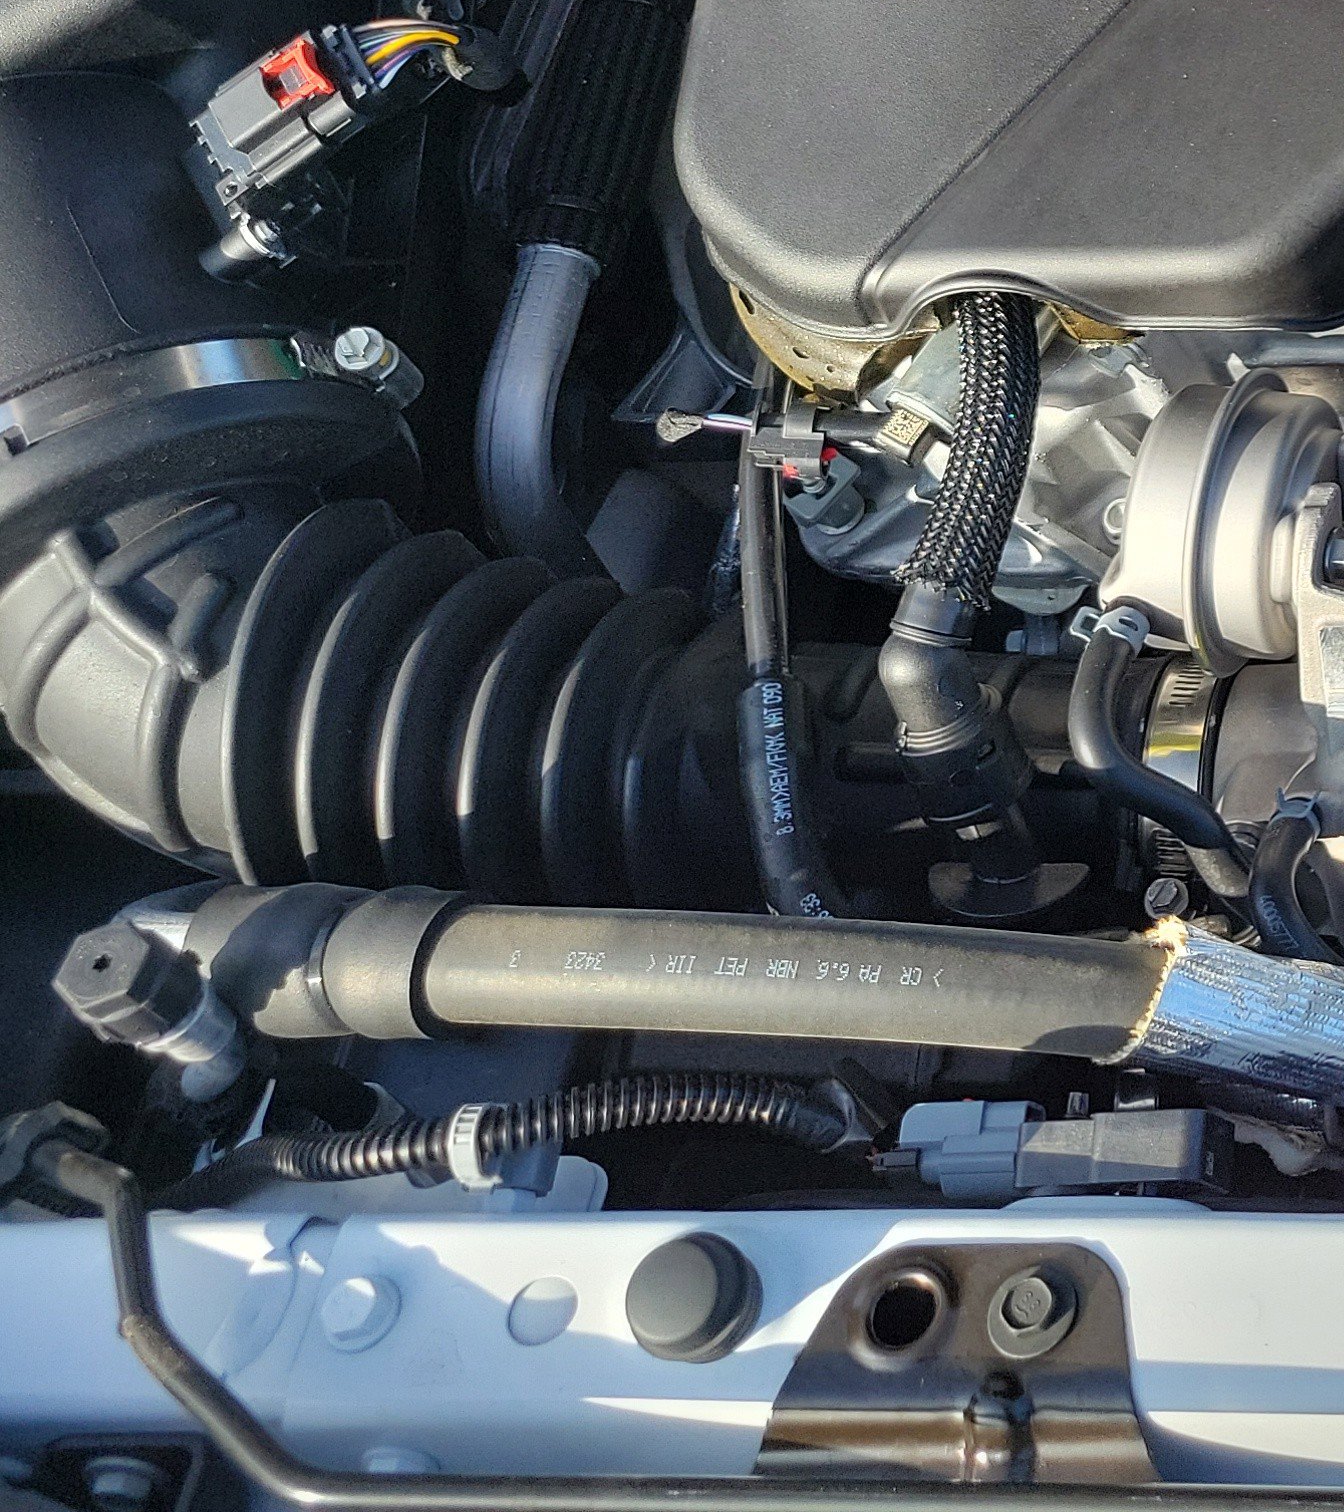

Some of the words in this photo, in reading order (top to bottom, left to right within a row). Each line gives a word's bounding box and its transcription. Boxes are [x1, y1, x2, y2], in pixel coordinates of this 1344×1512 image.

[563, 950, 607, 971] 3423
[664, 954, 696, 975] IIR
[714, 957, 750, 978] PET
[765, 958, 800, 980] NBR
[857, 964, 883, 985] PA
[898, 965, 924, 987] CR
